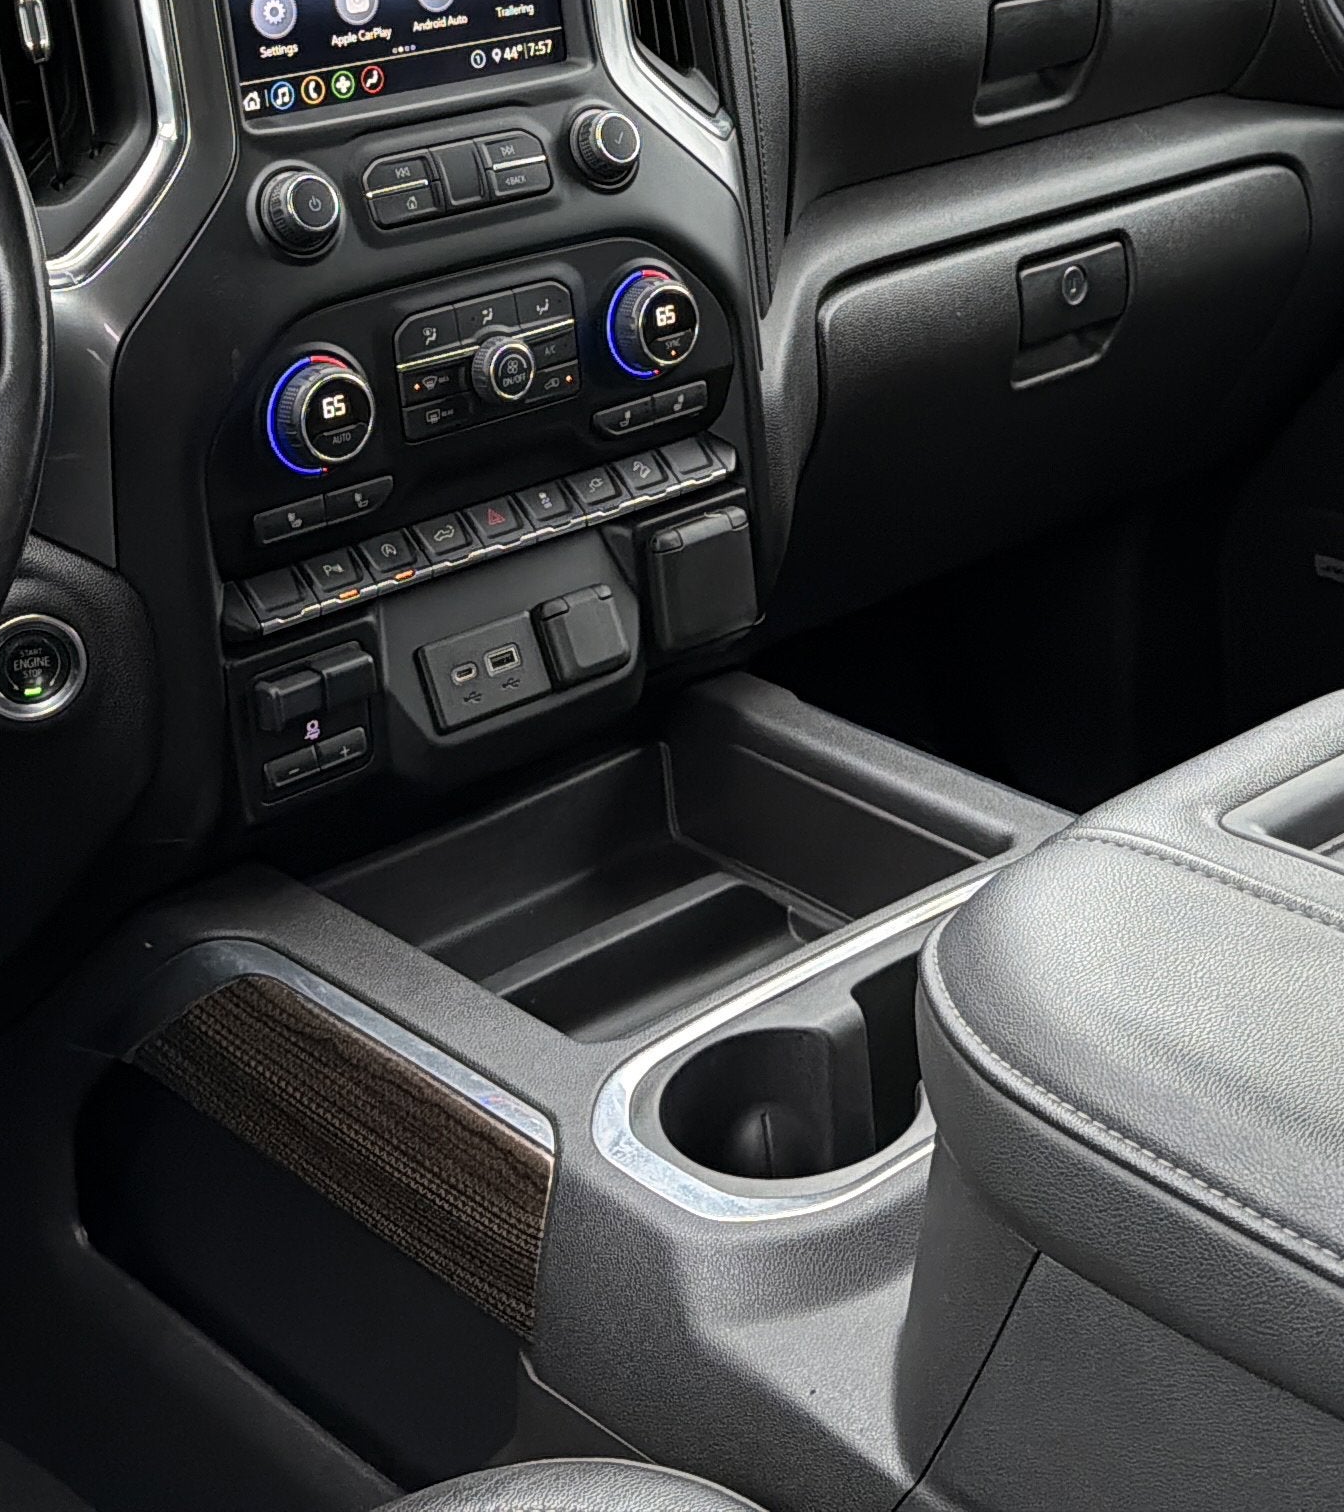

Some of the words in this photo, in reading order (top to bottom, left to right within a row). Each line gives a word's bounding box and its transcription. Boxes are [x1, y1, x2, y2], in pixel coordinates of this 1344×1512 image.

[495, 3, 535, 18] Trailering
[412, 16, 447, 32] Android
[446, 14, 469, 27] Auto
[331, 32, 357, 47] Apple
[357, 26, 393, 42] CarPlay
[259, 43, 299, 58] Settings
[529, 39, 553, 57] 7:57
[656, 304, 676, 326] 65
[502, 372, 526, 387] ON/OFF
[322, 394, 346, 419] 65
[332, 432, 352, 445] AUTO
[20, 647, 43, 657] START
[13, 655, 51, 671] ENGINE
[22, 669, 43, 678] STOP
